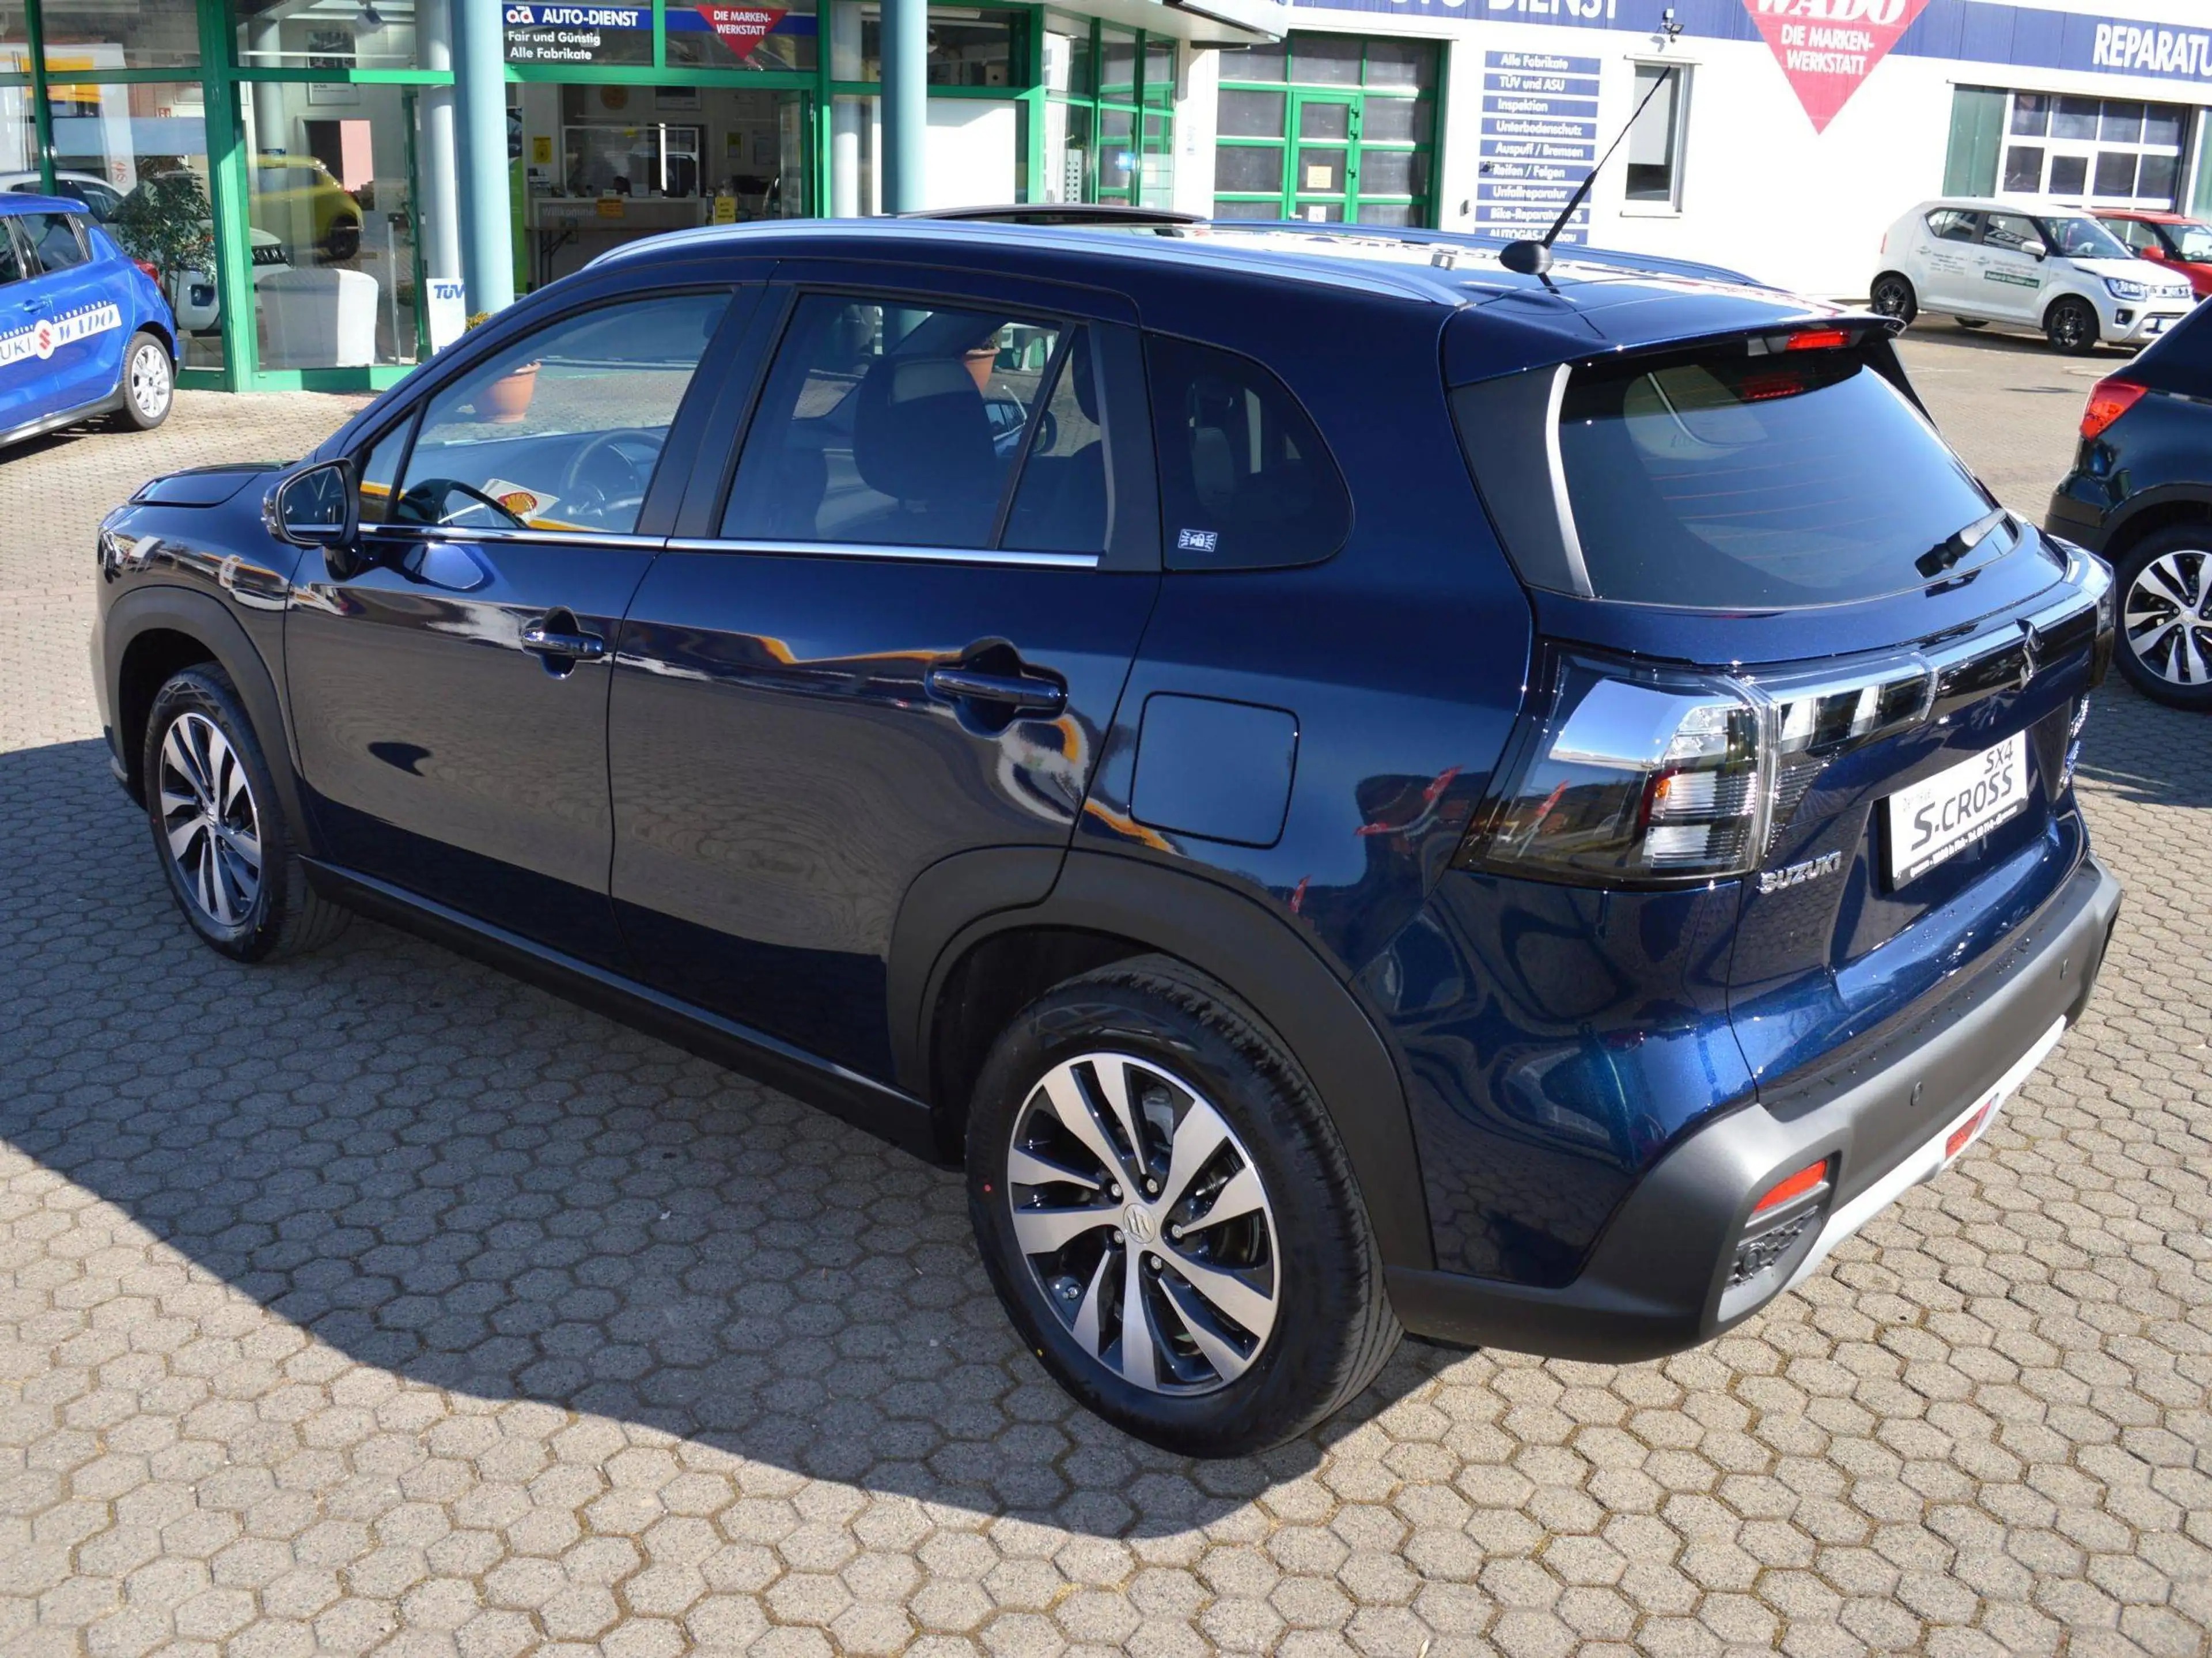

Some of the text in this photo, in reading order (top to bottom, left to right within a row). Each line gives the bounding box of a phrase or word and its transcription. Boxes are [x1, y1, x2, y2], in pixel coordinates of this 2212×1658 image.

[542, 9, 638, 27] AUTO-DIENST
[713, 10, 771, 22] DIE MARKEN-
[716, 24, 766, 35] WERKSTATT
[507, 31, 601, 47] Fair und Günstig
[1781, 24, 1875, 52] DIE MARKEN-
[510, 47, 592, 60] Alle Fabrikate
[1500, 53, 1569, 70] Alle Fabrikate
[1786, 50, 1866, 75] WERKSTATT
[1522, 77, 1542, 90] und
[1543, 78, 1565, 92] ASU
[1498, 97, 1548, 113] Inspektion
[1496, 120, 1582, 137] Unterbodenschutz
[1495, 142, 1535, 157] Auspuff
[1543, 144, 1584, 158] Bremsen
[1493, 164, 1523, 177] Reifen
[1533, 166, 1565, 180] Felgen
[1493, 186, 1567, 200] Unfallreparatur
[1983, 739, 2013, 774] SX4
[1756, 851, 1842, 894] SUZUKI
